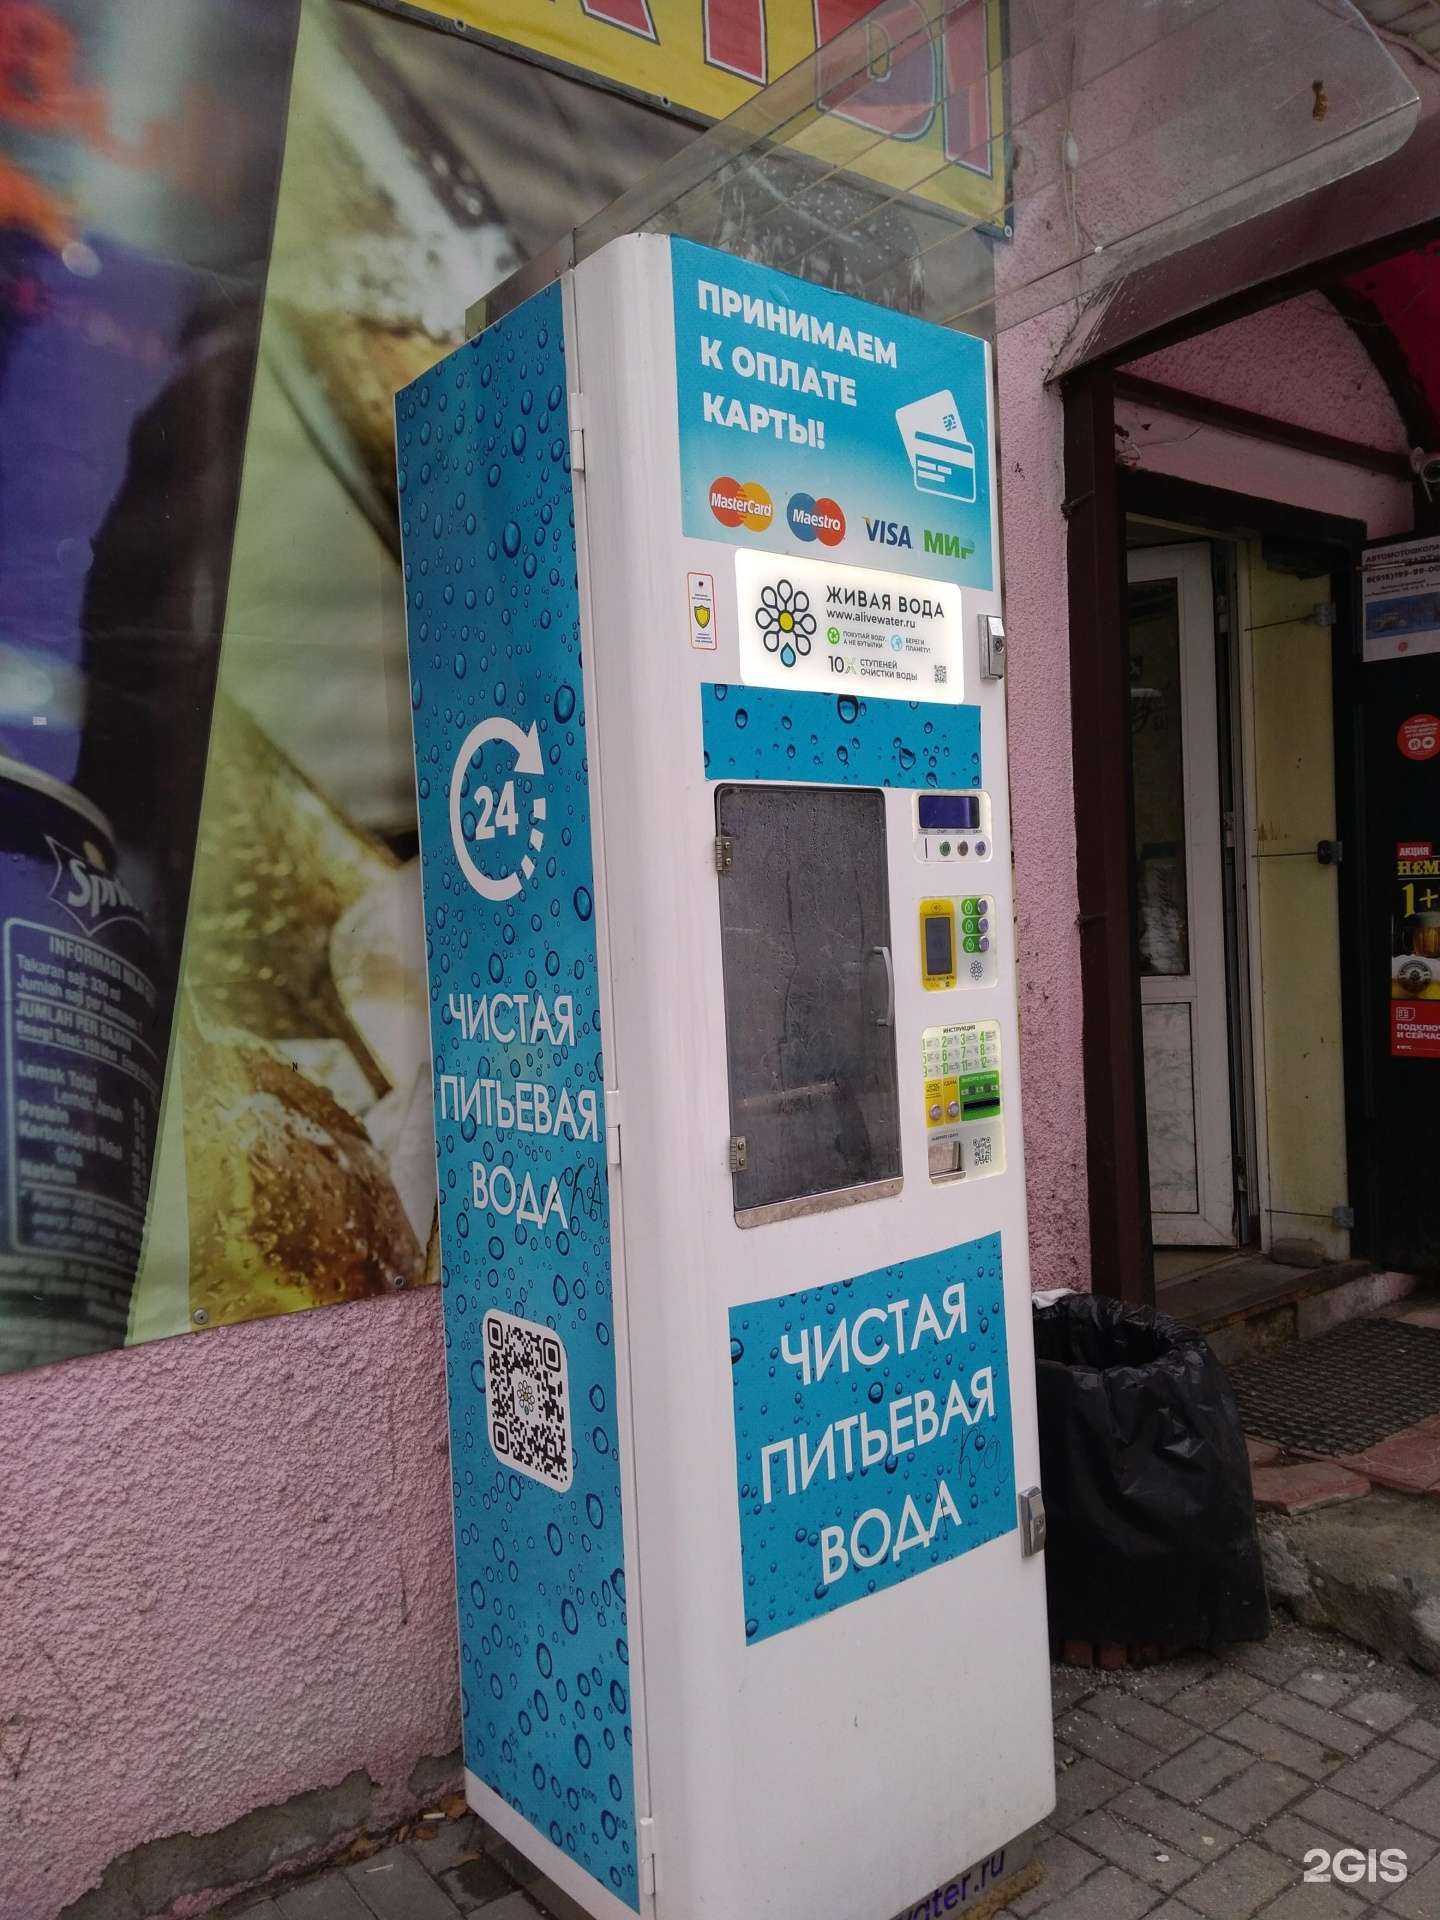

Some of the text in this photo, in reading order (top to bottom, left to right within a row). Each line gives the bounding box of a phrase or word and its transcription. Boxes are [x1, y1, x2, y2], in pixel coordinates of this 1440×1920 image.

[697, 279, 898, 369] ПРИНИМАЕМ
[700, 335, 858, 408] К ОПЛАТЕ
[703, 391, 826, 450] КАРТЫ!
[710, 491, 773, 519] MasterCard
[792, 508, 842, 533] Maestro
[863, 516, 913, 550] VISA
[923, 528, 976, 560] МИР
[826, 584, 946, 619] ЖИВАЯ ВОДА
[826, 608, 917, 629] www.alivewater.ru
[828, 655, 845, 674] 10
[860, 658, 898, 670] СТУПЕНЕЙ
[860, 668, 917, 681] ОЧИСТКИ ВОДЫ
[473, 779, 520, 842] 24
[1399, 846, 1430, 857] АКЦИЯ
[48, 935, 122, 980] INFORMASI
[16, 999, 73, 1027] JUMLAH
[447, 993, 576, 1047] ЧИСТАЯ
[943, 1024, 976, 1034] ИНСТРУКЦИЯ
[439, 1073, 599, 1143] ПИТЬЕВАЯ
[472, 1160, 570, 1230] ВОДА
[780, 1282, 968, 1386] ЧИСТАЯ
[760, 1365, 996, 1504] ПИТЬЕВАЯ
[820, 1479, 962, 1585] ВОДА
[893, 1850, 1005, 1920] ater.ru
